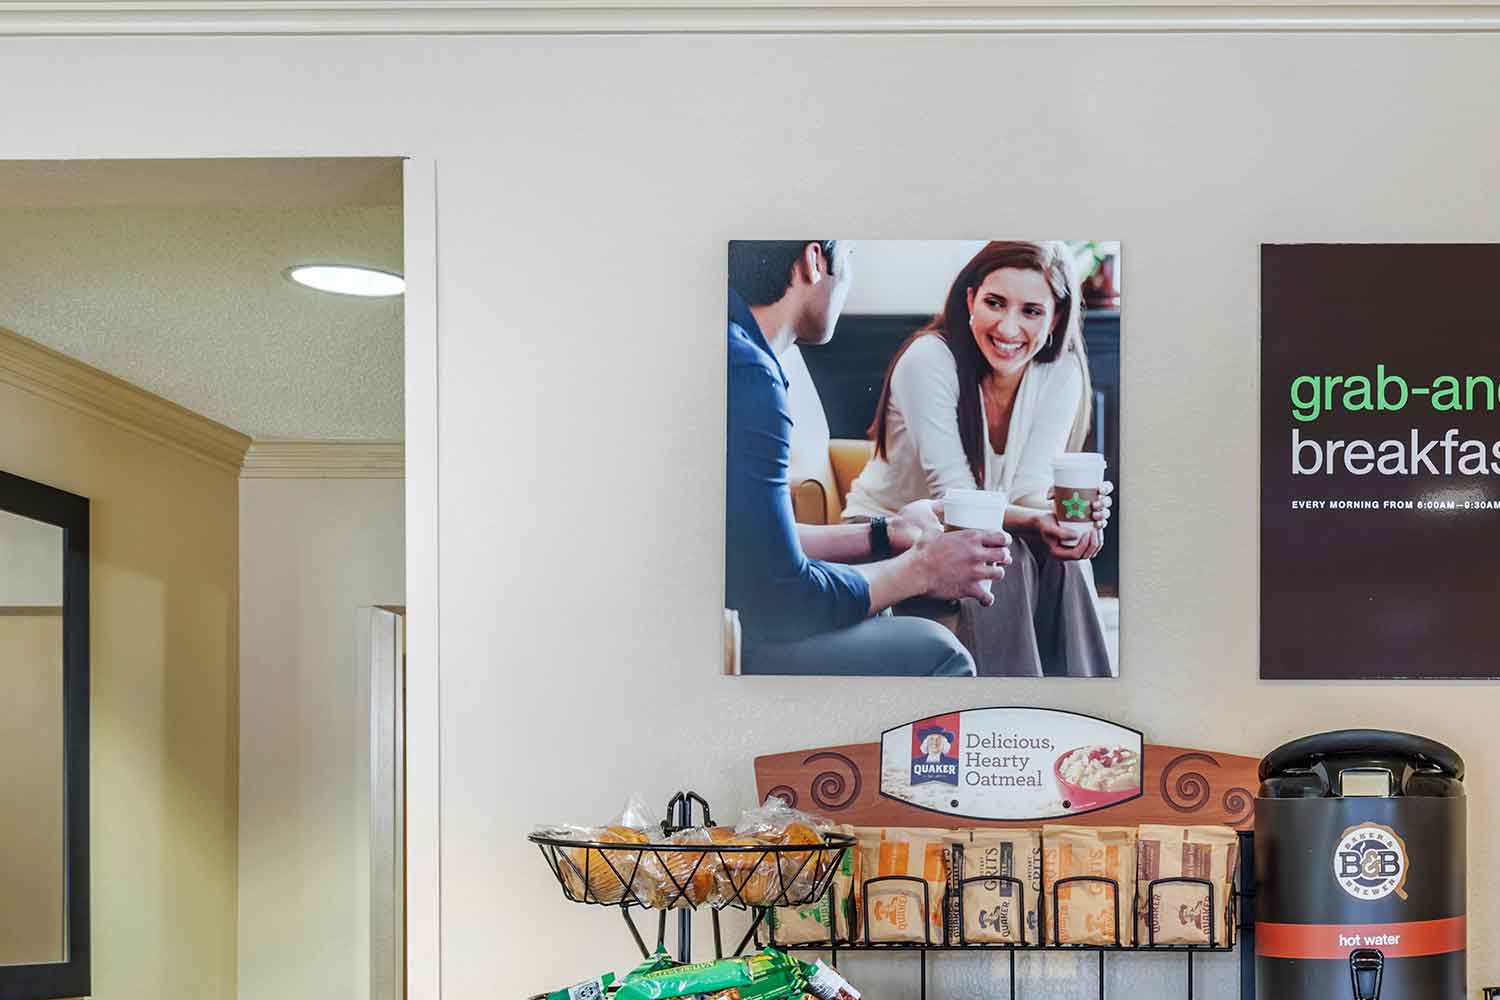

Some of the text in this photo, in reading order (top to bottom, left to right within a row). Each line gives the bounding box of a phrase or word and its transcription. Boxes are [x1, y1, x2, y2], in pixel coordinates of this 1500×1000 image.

[1291, 500, 1326, 509] EVERY
[1329, 500, 1379, 509] MORNING
[1383, 500, 1414, 509] FROM
[966, 732, 1055, 751] Delicious,
[914, 763, 957, 776] QUAKER
[966, 752, 1031, 771] Hearty
[966, 770, 1043, 787] Oatmeal
[1339, 850, 1401, 877] B&B
[1000, 901, 1010, 937] QUAKER
[1339, 933, 1401, 946] hot water
